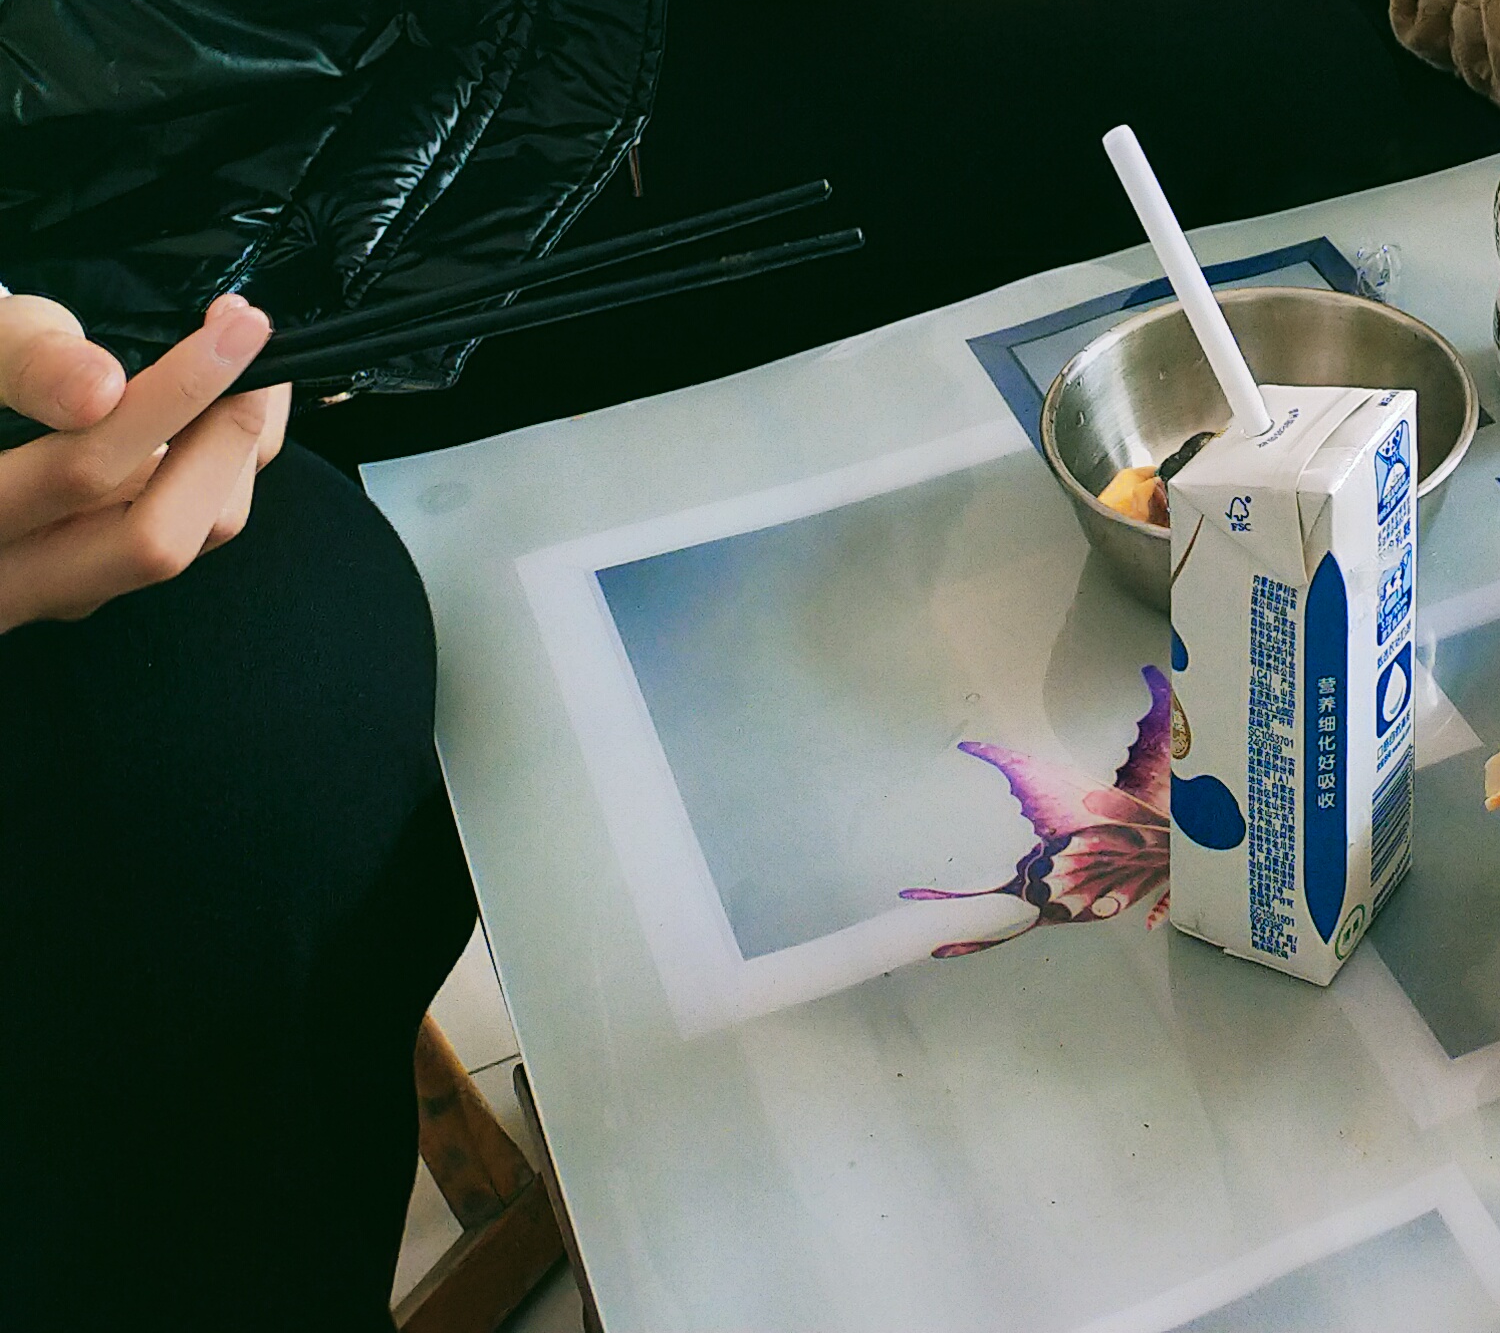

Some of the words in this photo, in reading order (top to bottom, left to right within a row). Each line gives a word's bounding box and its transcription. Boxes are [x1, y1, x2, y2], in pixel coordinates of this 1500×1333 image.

[1231, 522, 1251, 531] FSC
[1317, 676, 1336, 809] 营养细化好吸收
